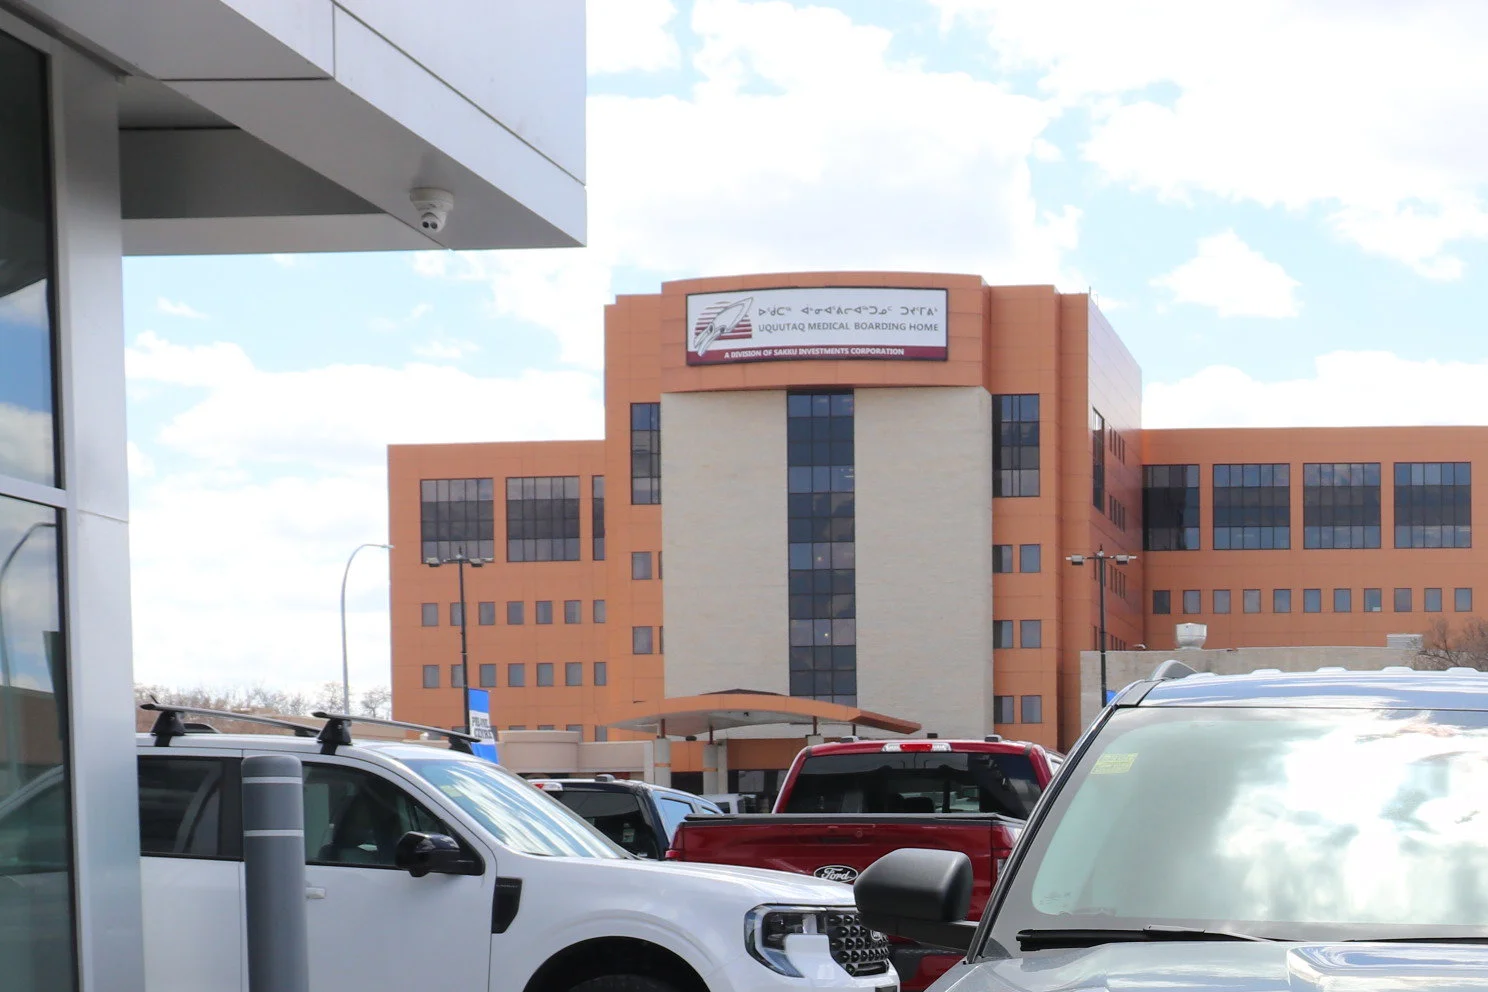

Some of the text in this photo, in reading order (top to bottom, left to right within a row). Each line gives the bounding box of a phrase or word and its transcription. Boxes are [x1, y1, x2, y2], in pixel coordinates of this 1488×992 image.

[758, 322, 939, 333] UQUUTAQ MEDICAL BOARDING HOME
[731, 350, 761, 358] DIVISION
[763, 349, 772, 357] OF
[773, 348, 797, 356] SAKKU
[798, 347, 849, 356] INVESTMENTS
[850, 347, 905, 355] CORPORATION
[821, 867, 851, 880] Ford
